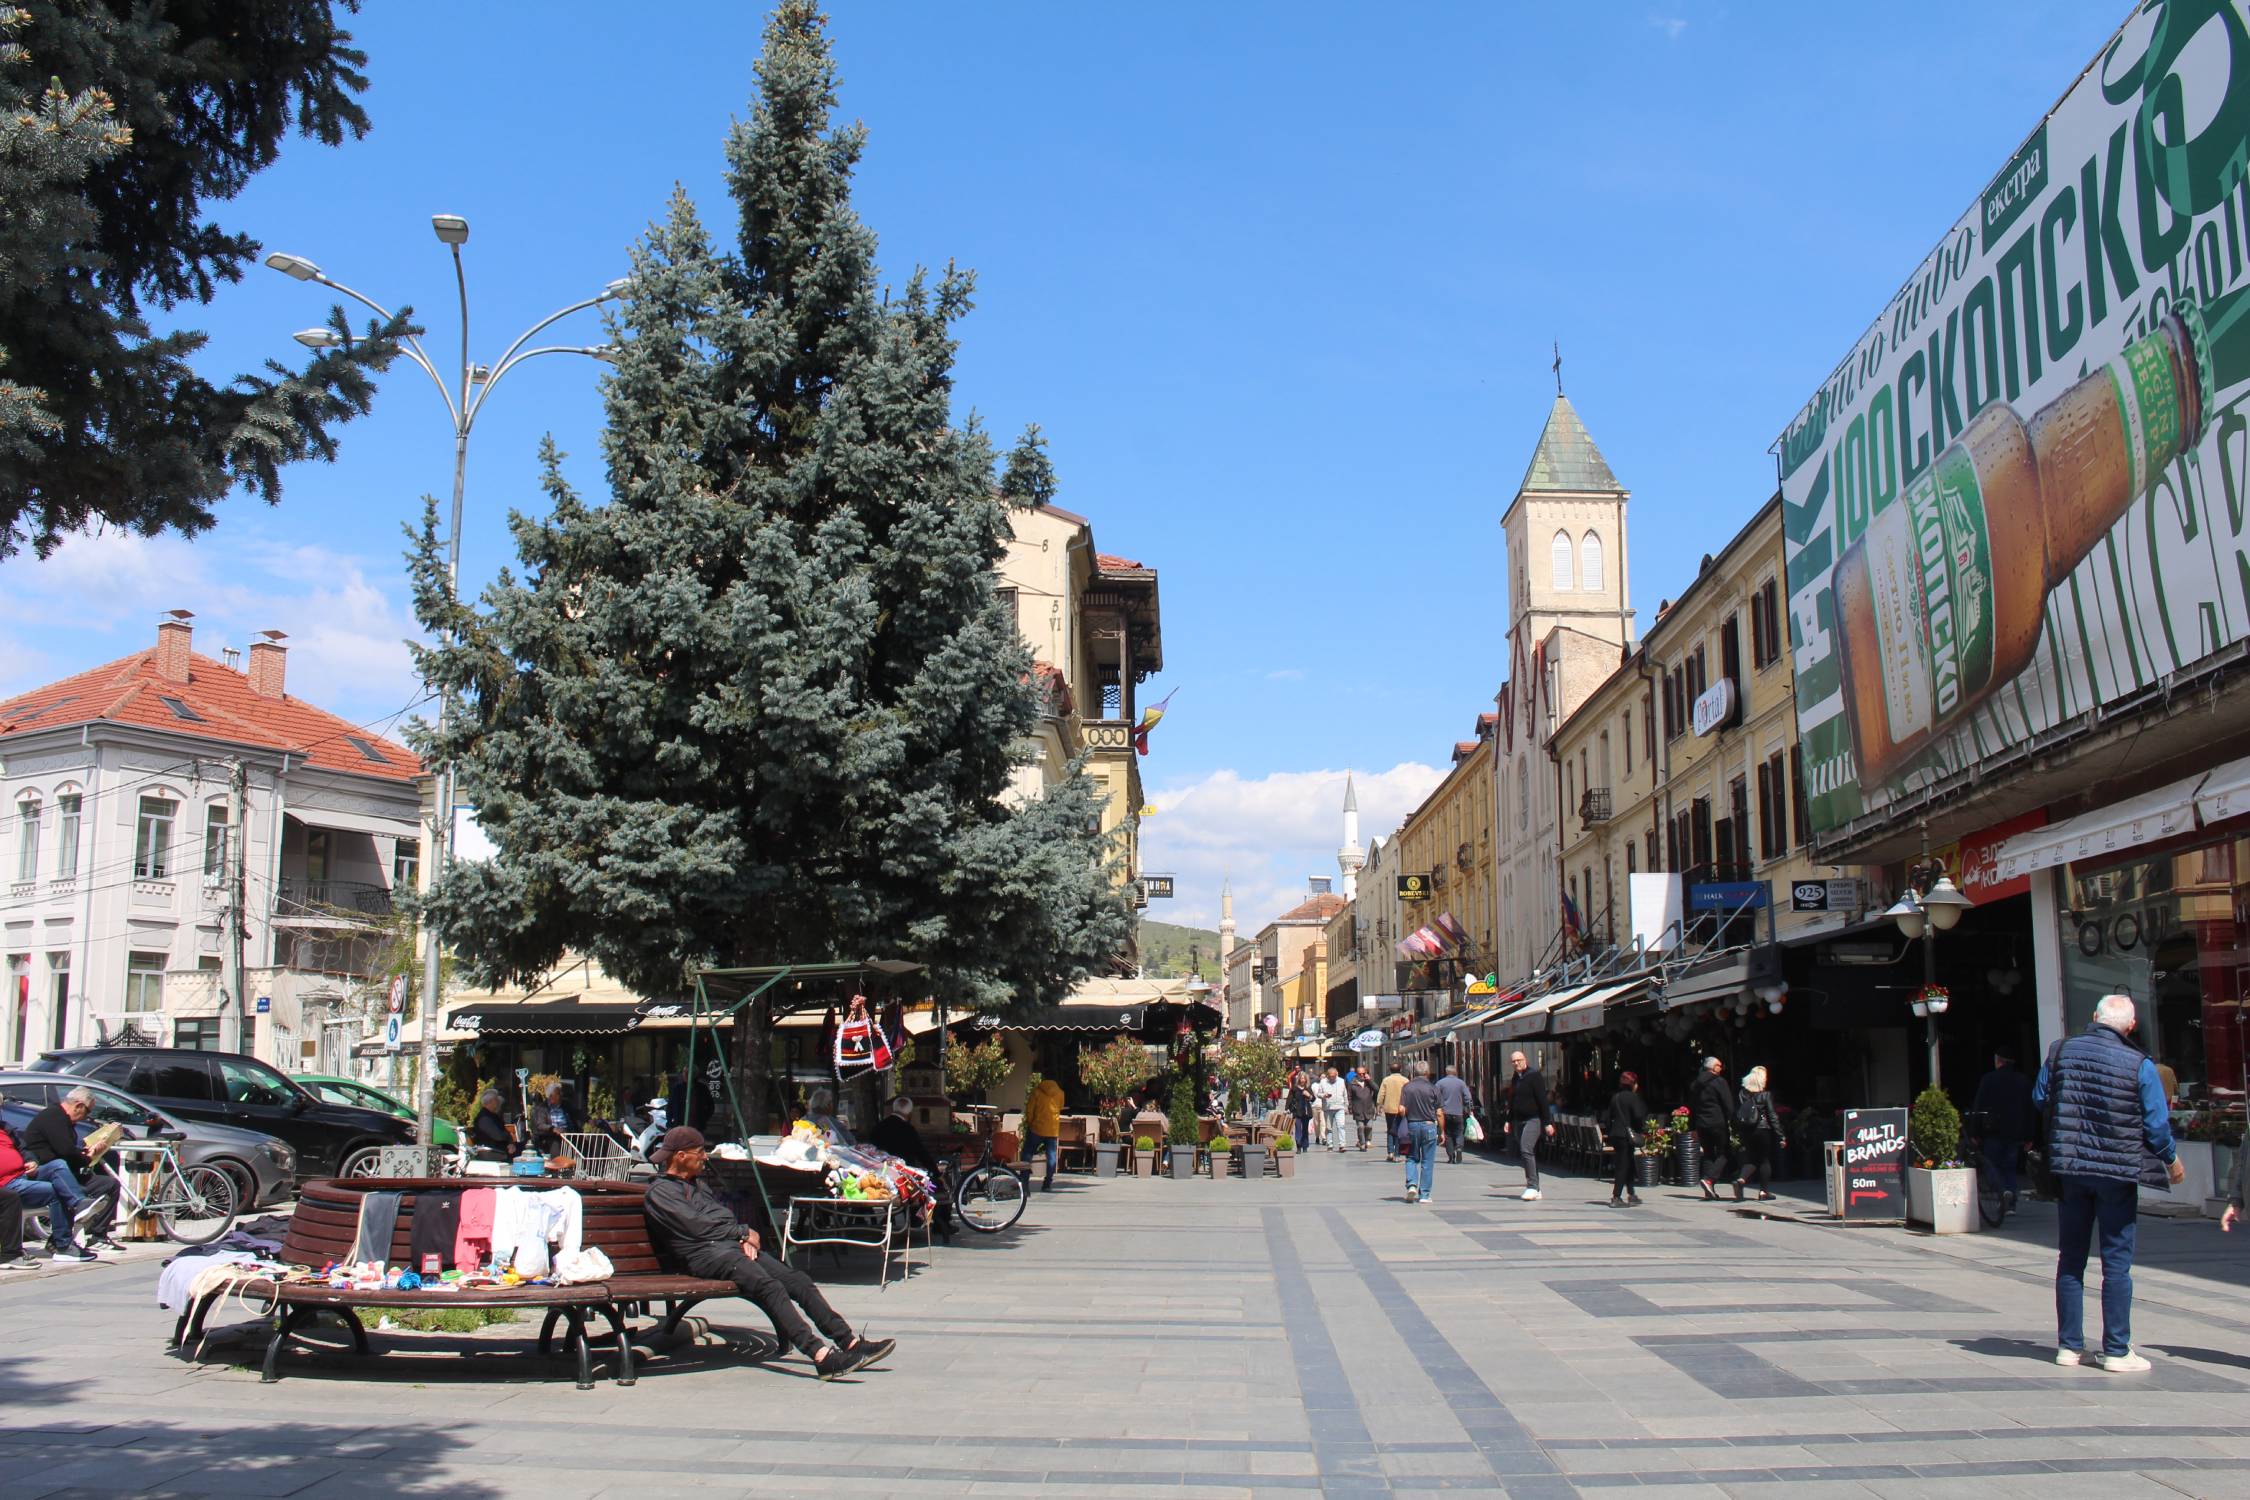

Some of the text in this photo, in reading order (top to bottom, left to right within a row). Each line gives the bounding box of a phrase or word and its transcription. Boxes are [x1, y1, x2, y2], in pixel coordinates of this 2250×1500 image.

[1987, 148, 2040, 226] екстра
[1911, 474, 1958, 715] СКОПСКО
[1799, 886, 1822, 899] 925
[1846, 1135, 1906, 1164] BRANDS
[1852, 1178, 1877, 1188] 50m
